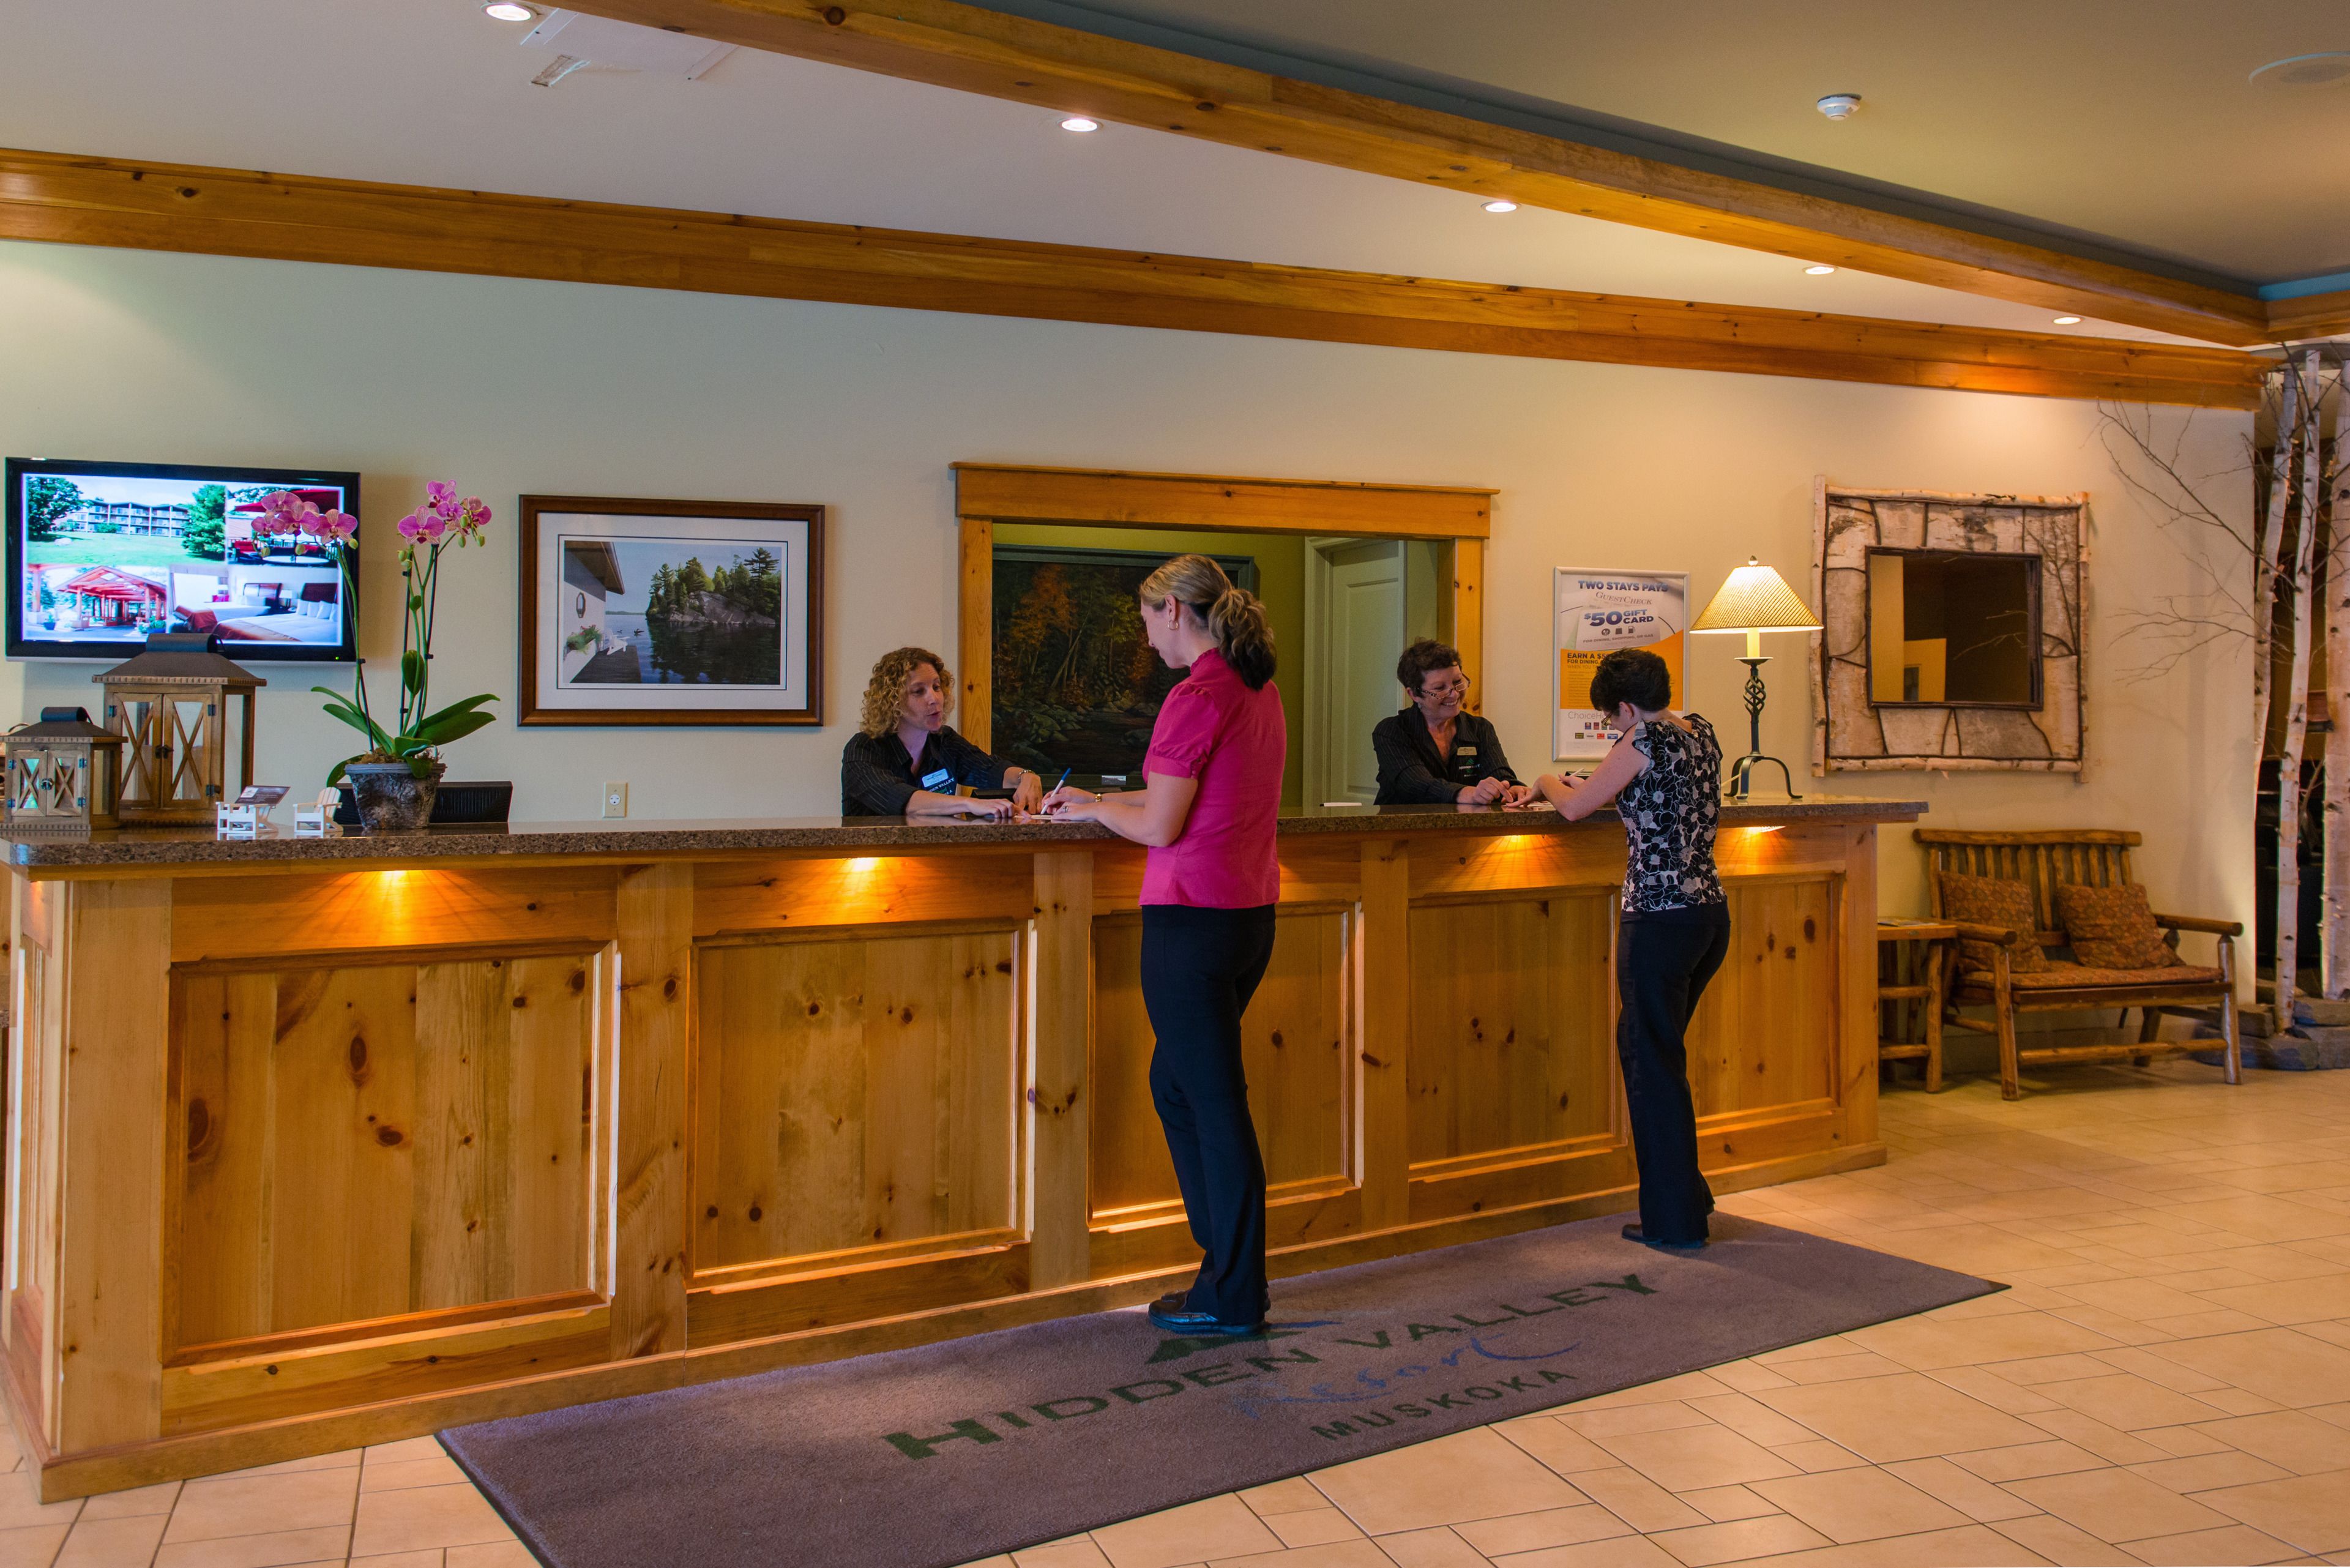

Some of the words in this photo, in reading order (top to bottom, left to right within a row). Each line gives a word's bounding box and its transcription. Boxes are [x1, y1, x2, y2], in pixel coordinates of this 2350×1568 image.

[1578, 580, 1604, 590] TWO
[1606, 582, 1639, 591] STAYS
[1642, 583, 1669, 592] PAYS
[1584, 611, 1622, 627] $50
[882, 1348, 1323, 1461] HIDDEN
[1336, 1274, 1658, 1350] VALLEY
[1310, 1370, 1578, 1441] MUSKOKA
